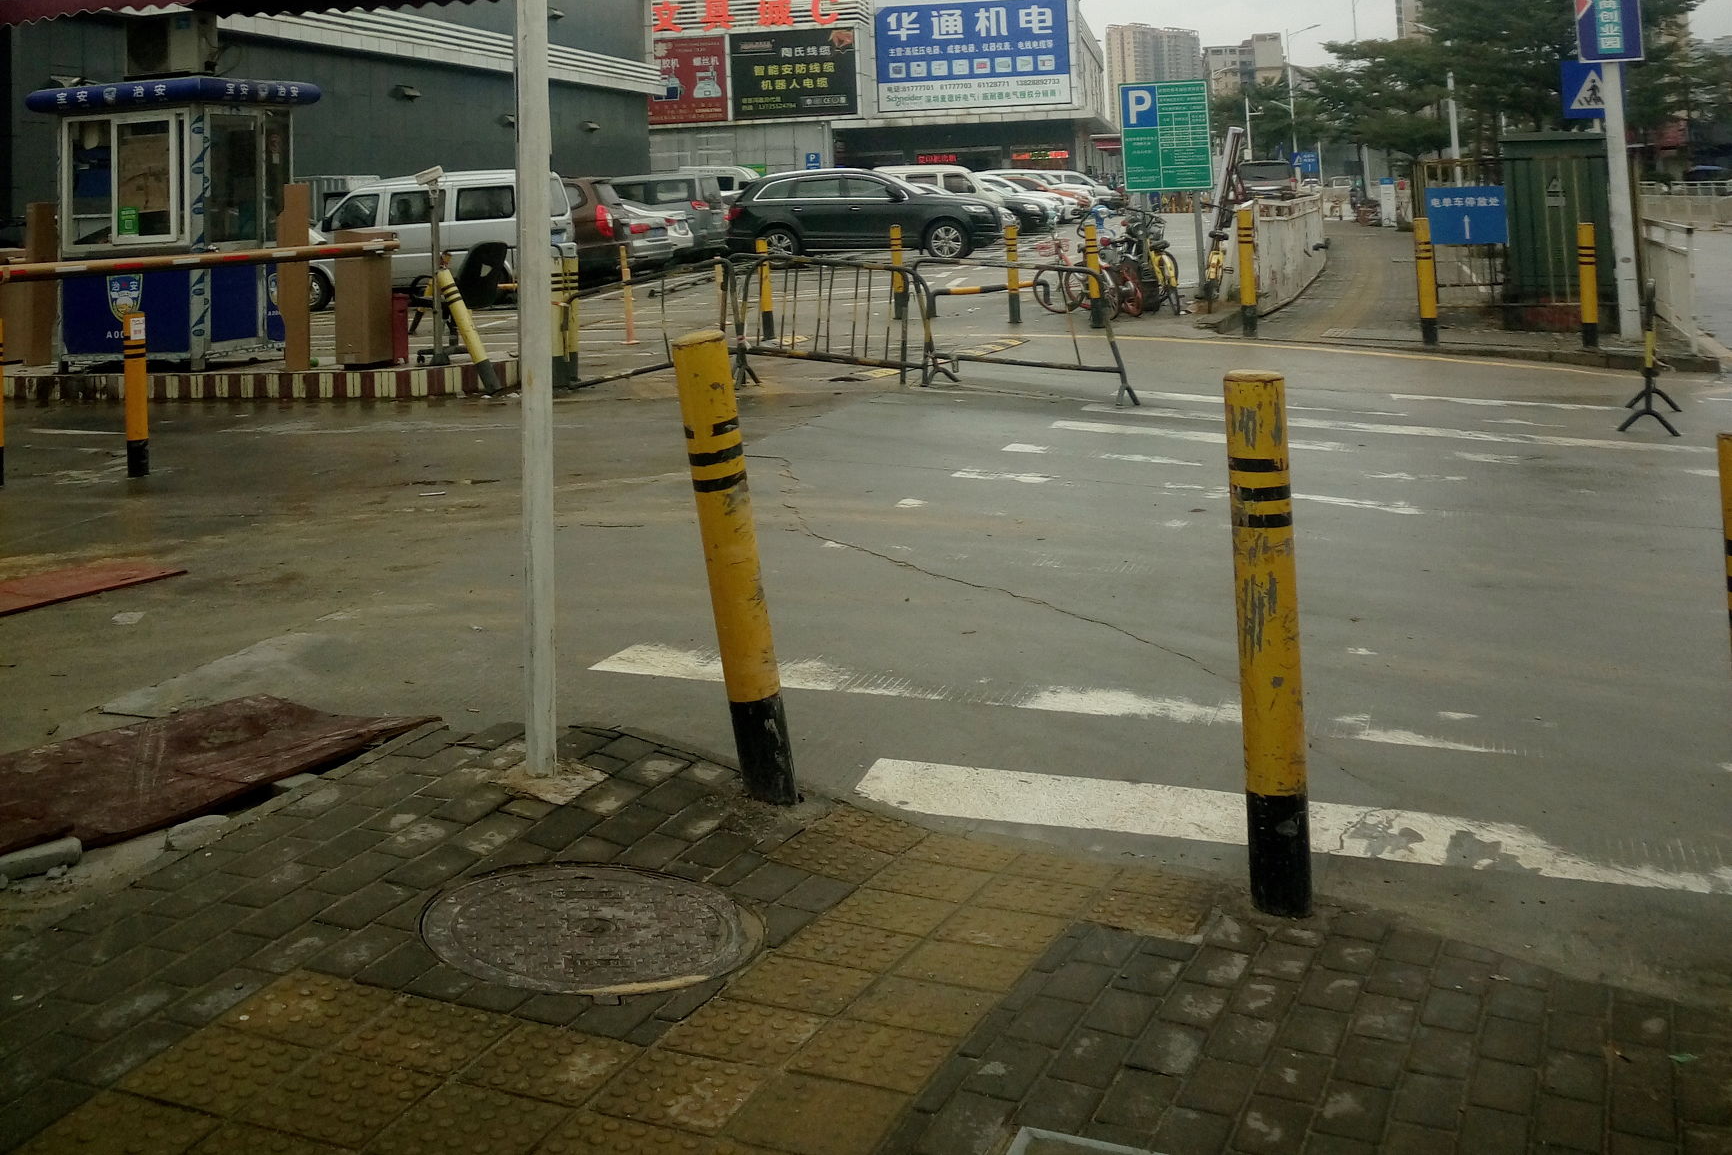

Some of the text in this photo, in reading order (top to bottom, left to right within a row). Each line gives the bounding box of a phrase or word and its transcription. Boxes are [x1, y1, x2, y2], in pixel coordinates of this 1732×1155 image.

[886, 4, 1053, 42] 华通机电
[753, 61, 835, 76] 智能安防线缆
[761, 77, 829, 91] 机器人电缆
[1128, 89, 1152, 125] P
